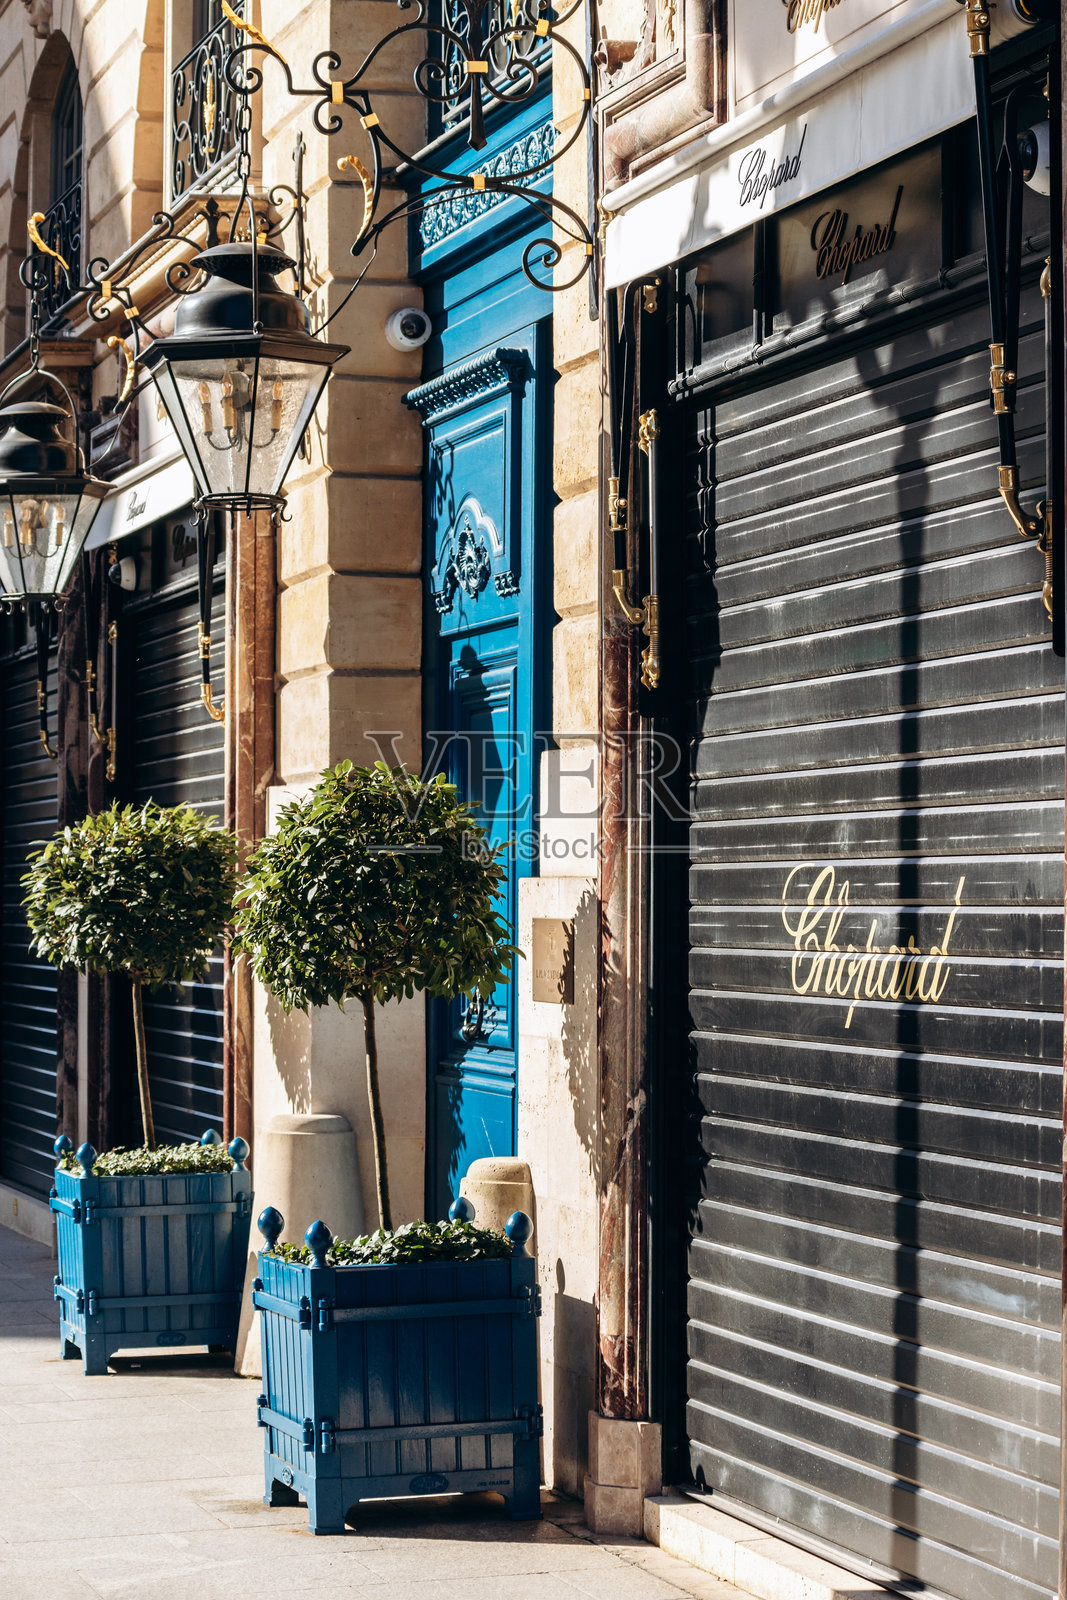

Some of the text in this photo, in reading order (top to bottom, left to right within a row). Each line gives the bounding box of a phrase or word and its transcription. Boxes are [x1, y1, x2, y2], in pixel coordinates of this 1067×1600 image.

[737, 123, 808, 210] Chopard
[810, 185, 904, 286] Chopard
[781, 862, 966, 1029] Chopard
